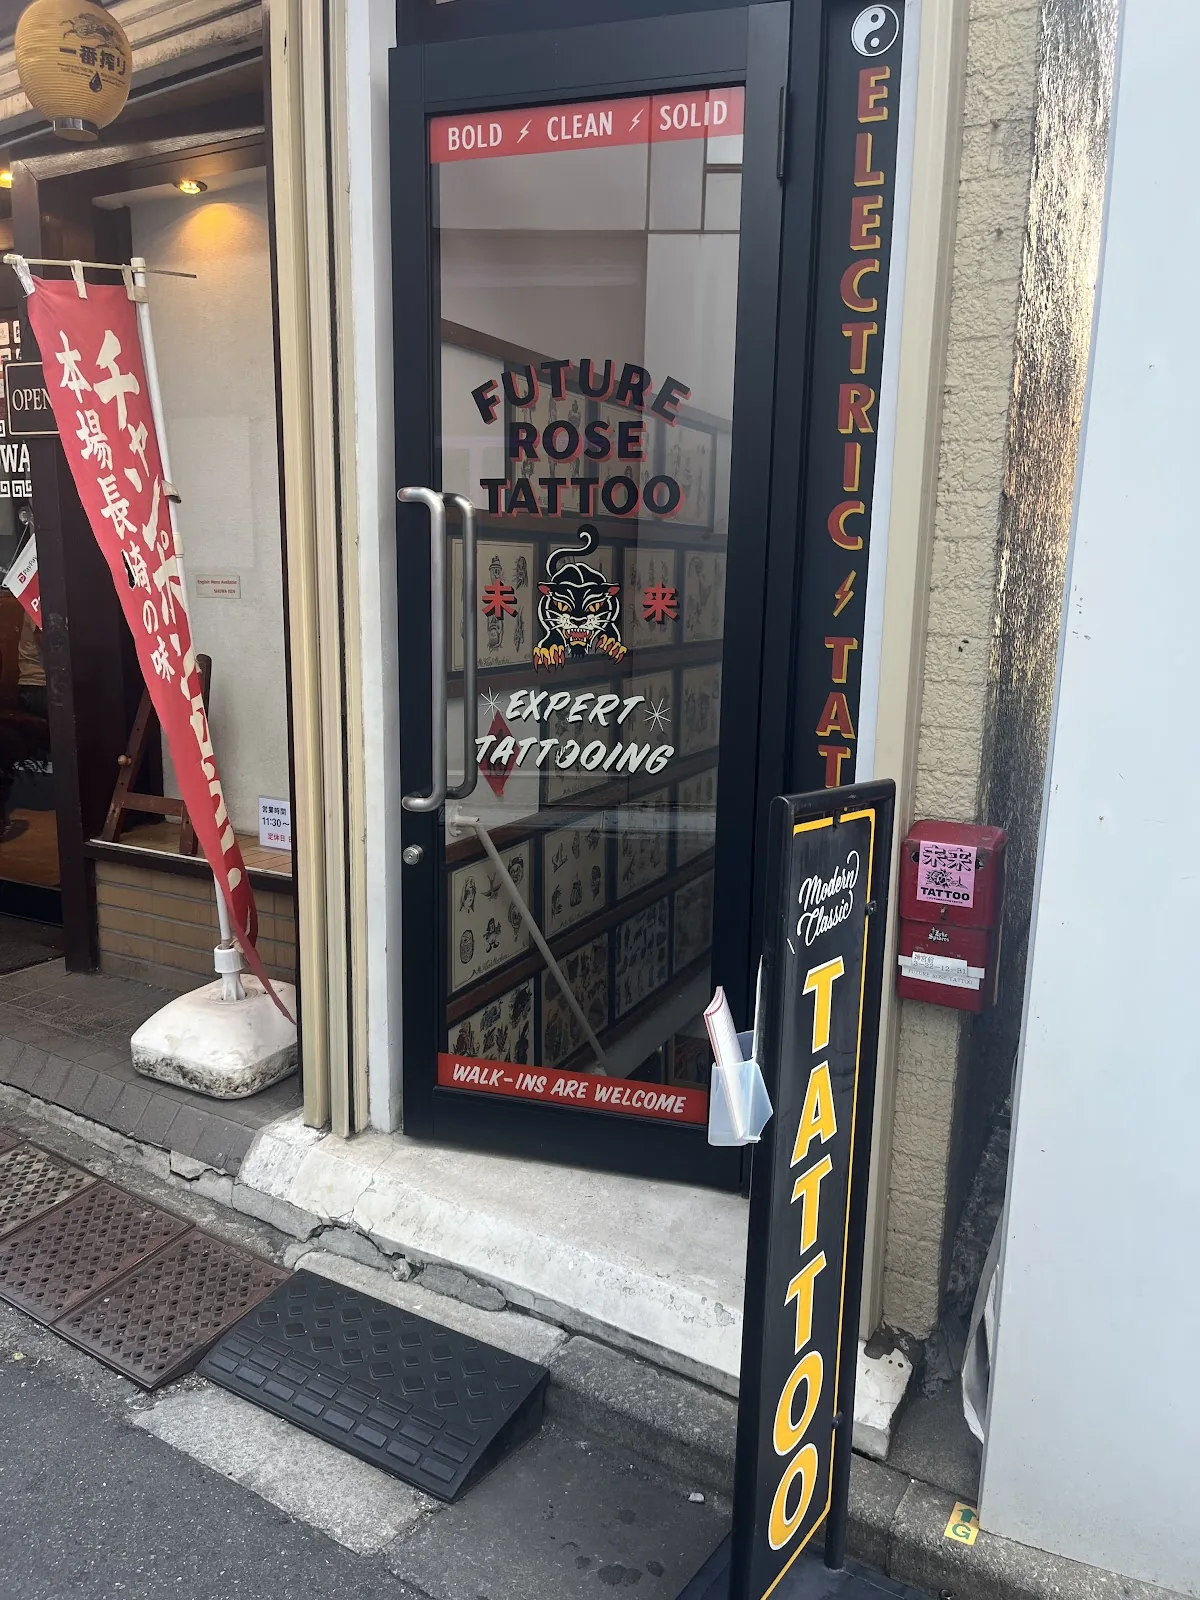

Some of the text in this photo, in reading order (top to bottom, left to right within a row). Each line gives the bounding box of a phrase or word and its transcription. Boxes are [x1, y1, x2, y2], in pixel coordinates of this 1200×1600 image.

[59, 45, 126, 76] 一番搾り
[448, 100, 728, 151] BOLD CLEAN SOLID
[827, 65, 891, 550] ELECTRIC
[12, 388, 53, 411] OPEN
[470, 358, 692, 428] FUTURE
[508, 420, 647, 464] ROSE
[479, 474, 685, 518] TATTOO
[481, 578, 681, 625] 未 来
[505, 689, 645, 728] EXPERT
[474, 734, 675, 775] TATTOOING
[262, 805, 287, 816] 営業時間
[267, 832, 286, 842] 定休日
[922, 844, 973, 872] 未来
[798, 850, 860, 911] Modern
[920, 886, 970, 901] TATTOO
[796, 889, 854, 946] Classic
[452, 1063, 687, 1114] WALK-INS ARE WELCOME
[767, 955, 845, 1552] TATTOO
[952, 1523, 971, 1540] G
